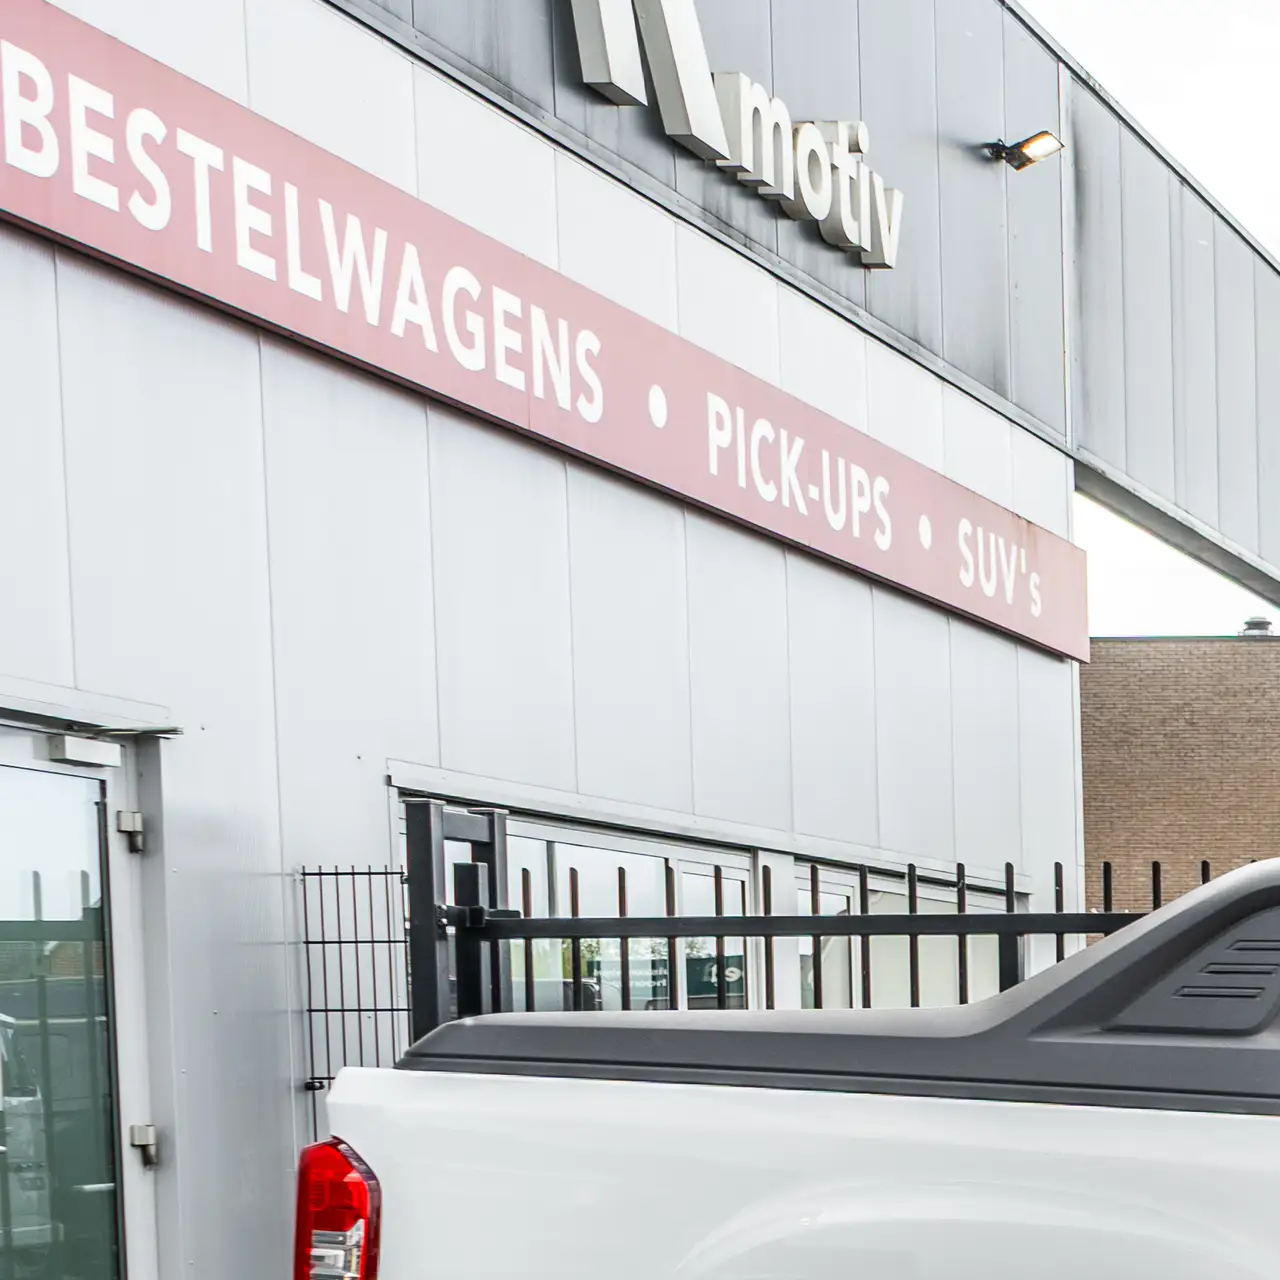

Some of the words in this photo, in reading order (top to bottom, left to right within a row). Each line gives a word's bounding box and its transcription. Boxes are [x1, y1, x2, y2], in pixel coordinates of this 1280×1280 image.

[0, 38, 603, 424] BESTELWAGENS
[706, 391, 893, 551] PICK-UPS
[957, 518, 1042, 618] SUV's
